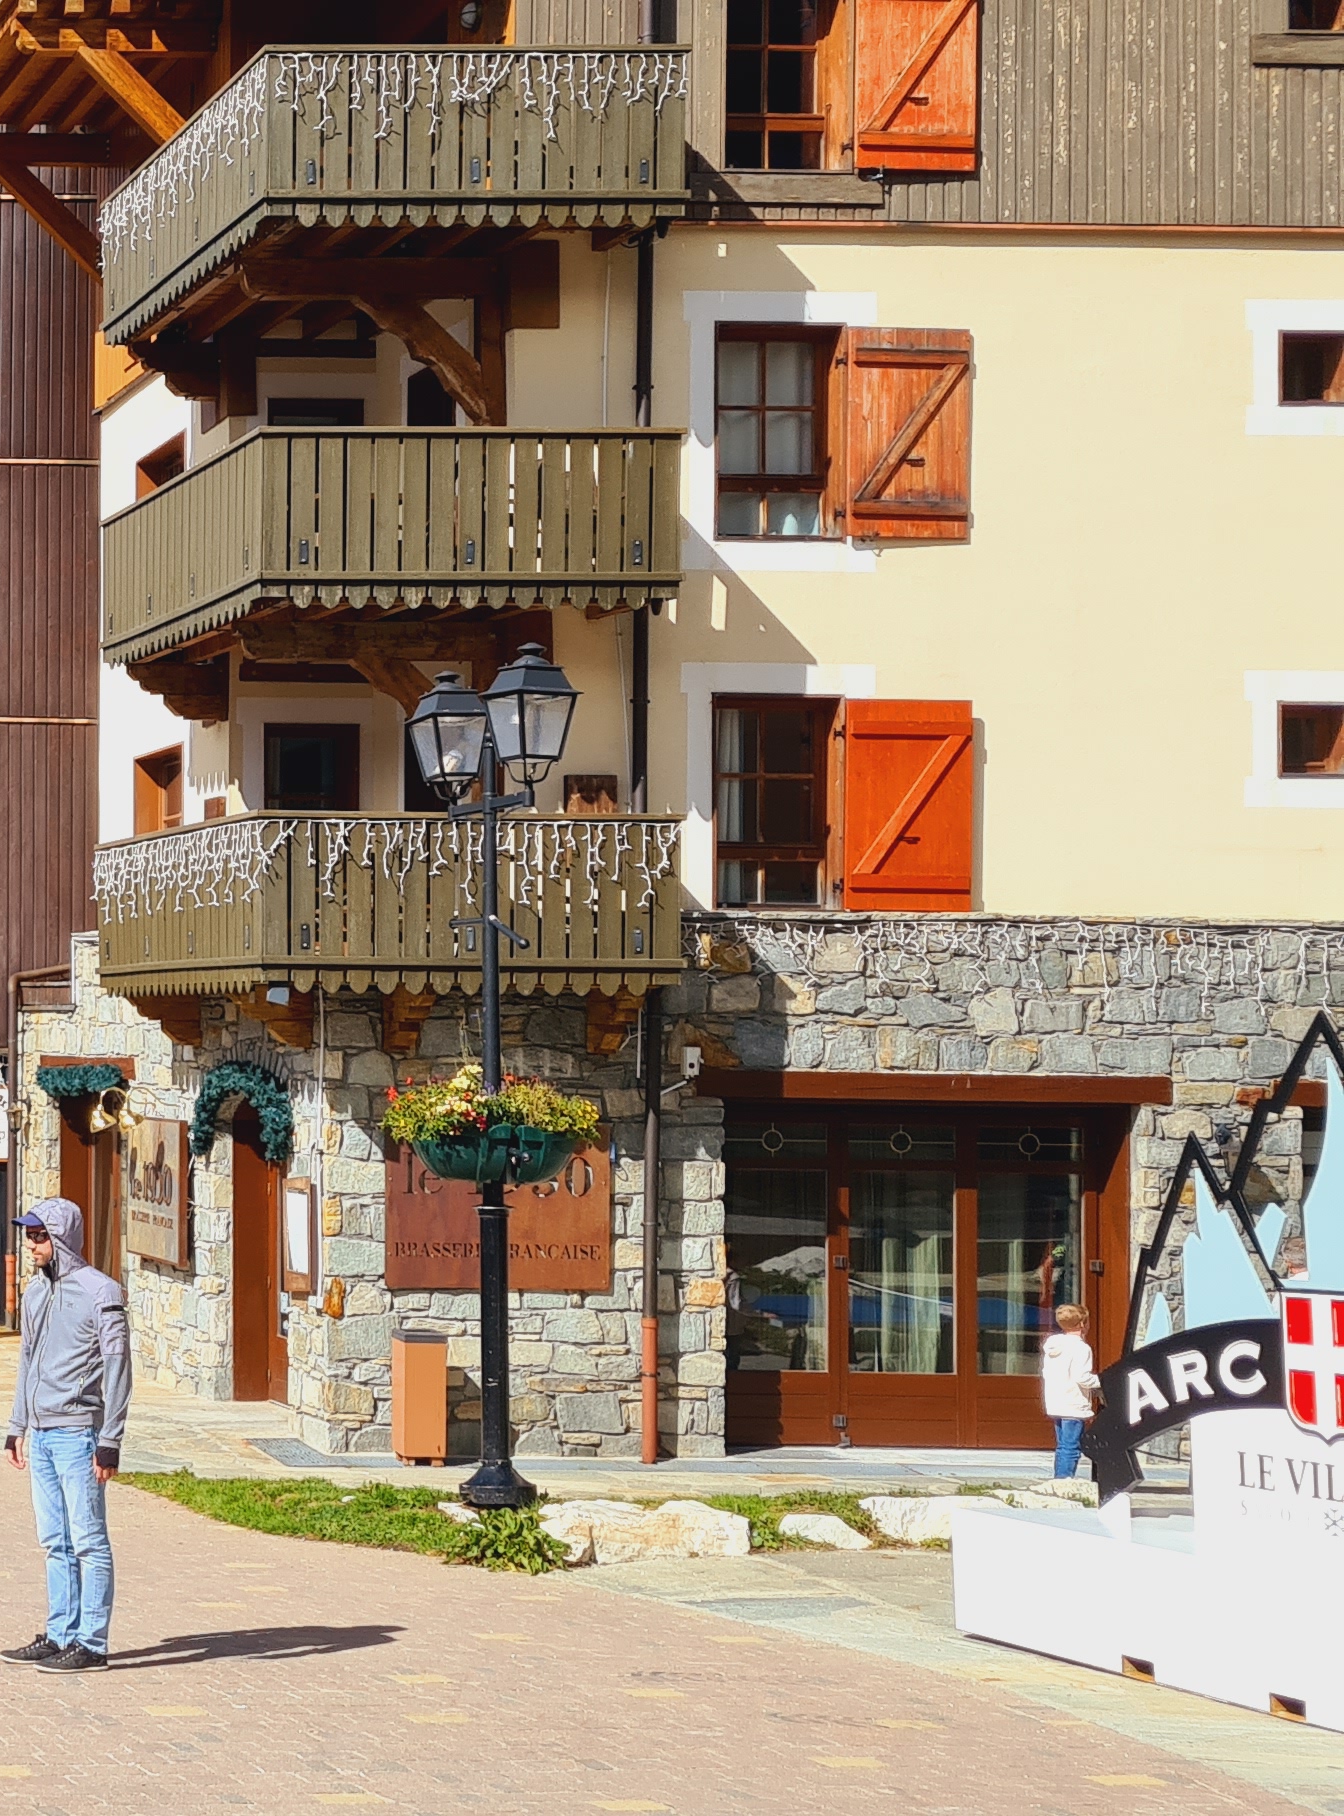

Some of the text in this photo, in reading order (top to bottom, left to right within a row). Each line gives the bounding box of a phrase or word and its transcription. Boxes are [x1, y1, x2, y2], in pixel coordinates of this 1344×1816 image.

[395, 1242, 480, 1258] BRASSERI
[1128, 1339, 1267, 1425] ARC
[1237, 1451, 1344, 1503] LE VIL
